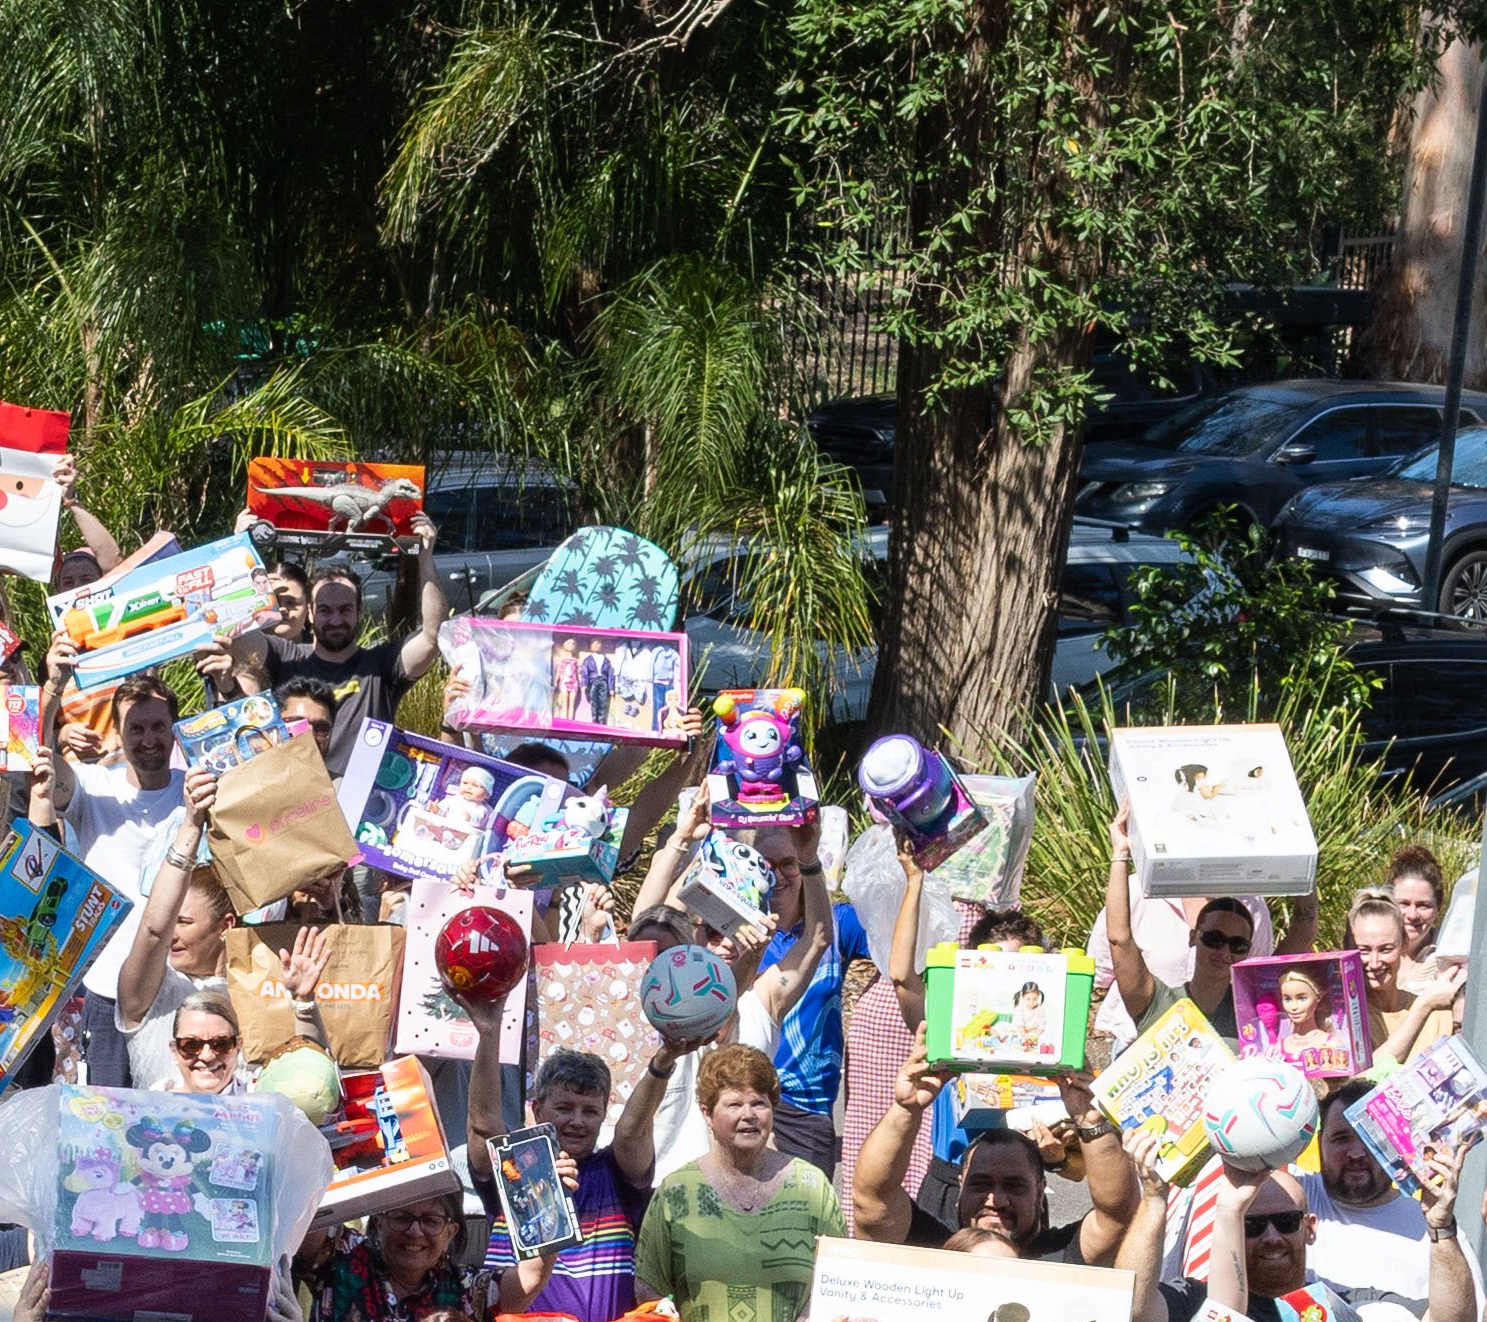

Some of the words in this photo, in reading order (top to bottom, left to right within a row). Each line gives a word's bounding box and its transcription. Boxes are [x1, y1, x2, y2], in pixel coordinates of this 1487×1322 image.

[177, 566, 213, 586] FAST
[270, 795, 331, 837] priceline
[738, 814, 747, 823] DJ
[779, 813, 796, 823] Star
[71, 886, 106, 932] STUNT
[87, 899, 108, 928] TRACKS
[260, 982, 381, 1001] ANONDA
[1106, 1063, 1144, 1100] WHO
[820, 1289, 856, 1303] Vanity
[860, 1294, 868, 1303] &
[872, 1296, 942, 1311] Accessories
[821, 1275, 859, 1288] Deluxe
[863, 1279, 908, 1293] Wooden
[914, 1285, 943, 1300] Light
[948, 1290, 964, 1302] Up
